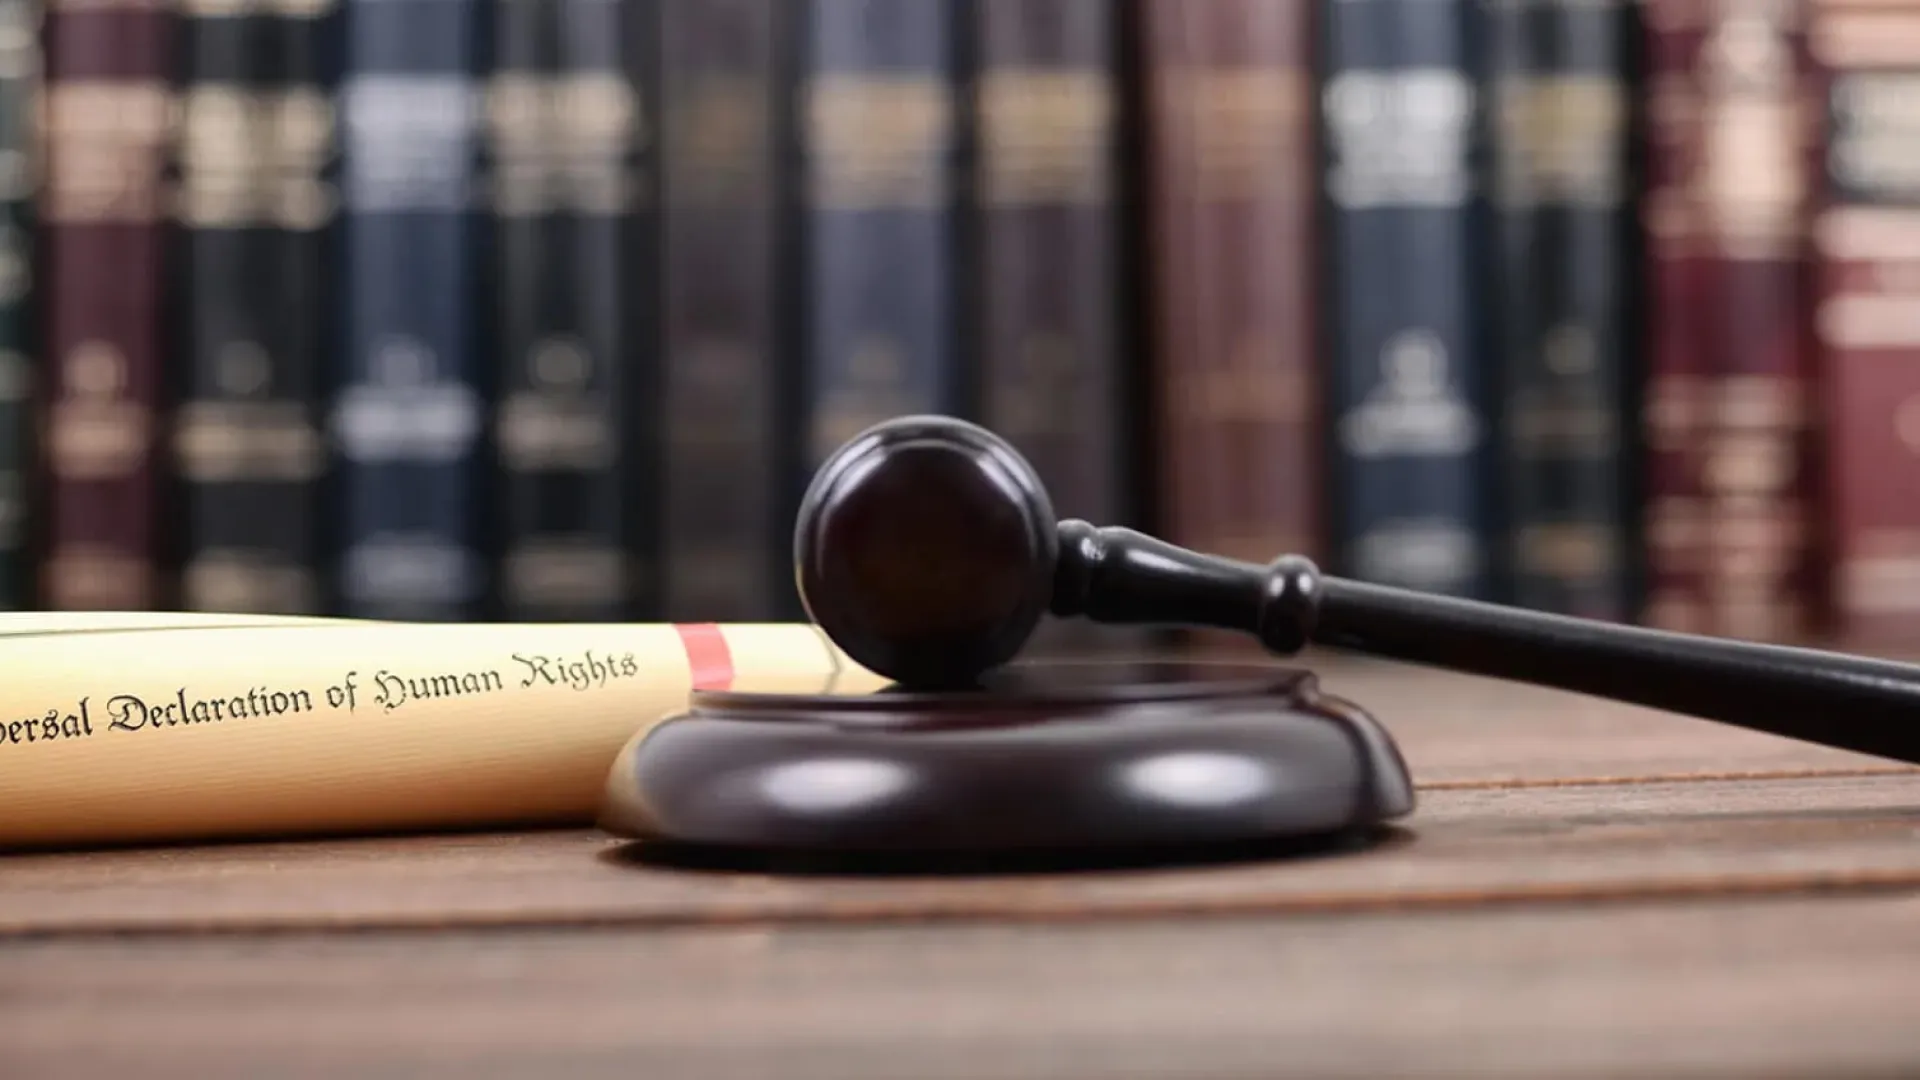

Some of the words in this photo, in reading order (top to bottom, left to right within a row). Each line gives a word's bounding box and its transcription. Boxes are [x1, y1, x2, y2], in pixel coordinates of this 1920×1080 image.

[107, 687, 312, 731] Declaration
[326, 671, 357, 713] of
[374, 669, 503, 713] Human
[512, 650, 638, 690] Rights
